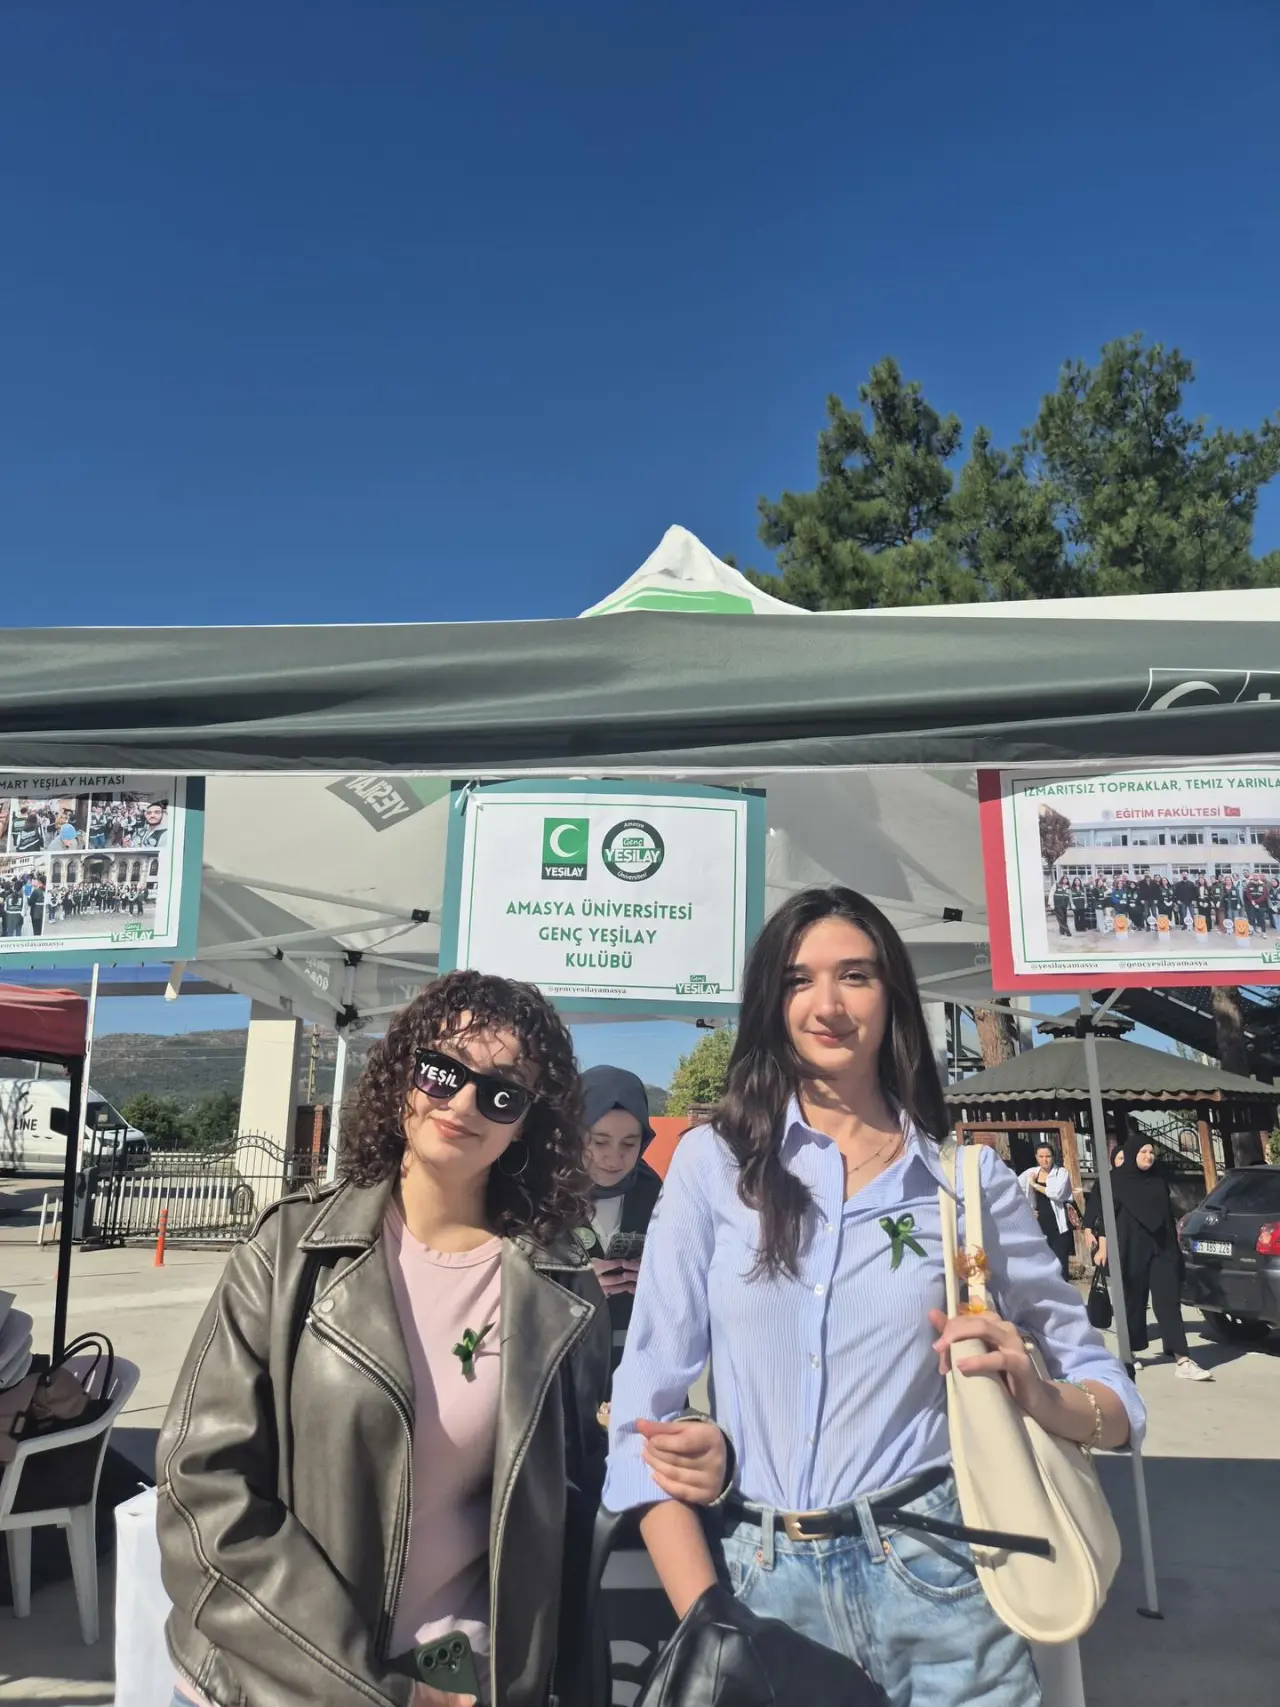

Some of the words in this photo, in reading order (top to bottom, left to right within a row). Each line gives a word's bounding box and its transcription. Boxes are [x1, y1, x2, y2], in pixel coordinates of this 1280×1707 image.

[1099, 780, 1181, 793] TOPRAKLAR,
[1157, 806, 1221, 818] FAKÜLTESİ
[506, 901, 574, 916] AMASYA
[582, 899, 692, 920] ÜNİVERSİTESİ
[539, 927, 583, 946] GENÇ
[589, 925, 657, 947] YEŞİLAY
[565, 950, 633, 969] KULÜBÜ
[420, 1062, 458, 1087] YEŞİL
[14, 1118, 38, 1131] LINE
